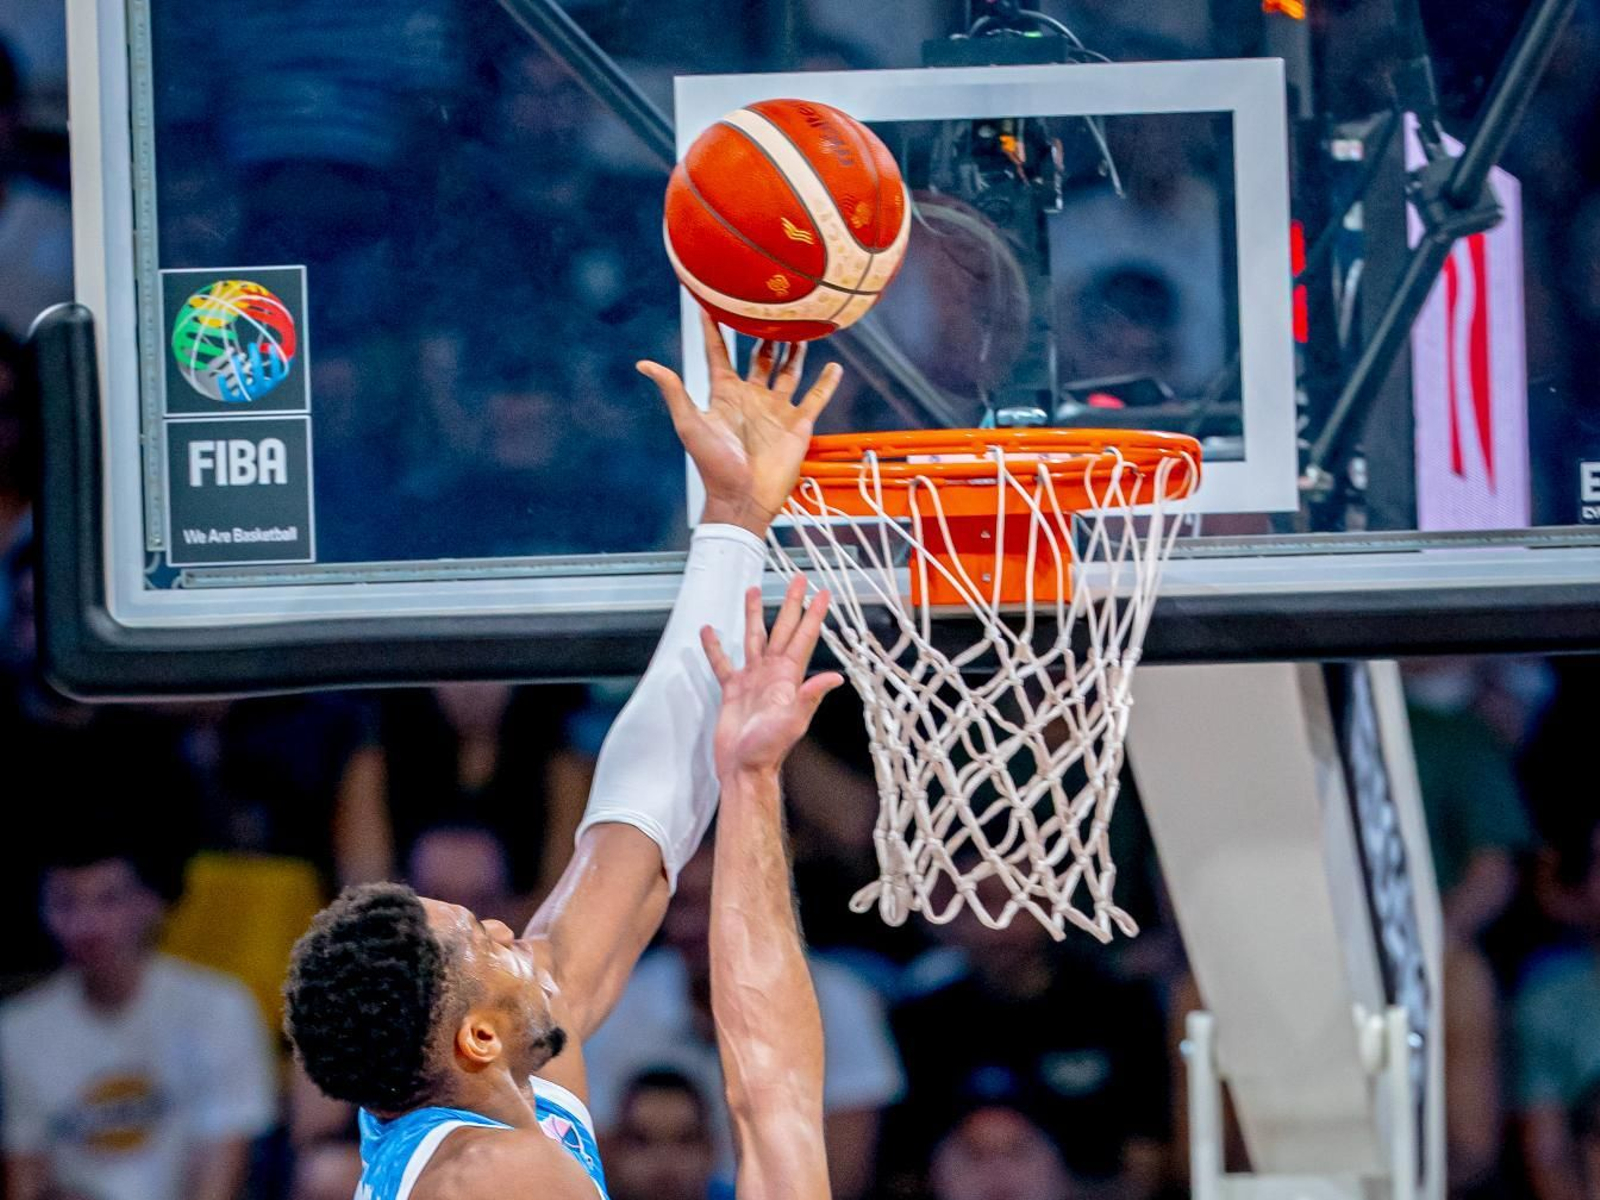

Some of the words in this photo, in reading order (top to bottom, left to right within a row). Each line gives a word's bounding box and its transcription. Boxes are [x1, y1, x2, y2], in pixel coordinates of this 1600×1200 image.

[188, 438, 288, 487] FIBA
[183, 529, 207, 544] We
[208, 528, 231, 543] Are
[232, 526, 298, 543] Basketball
